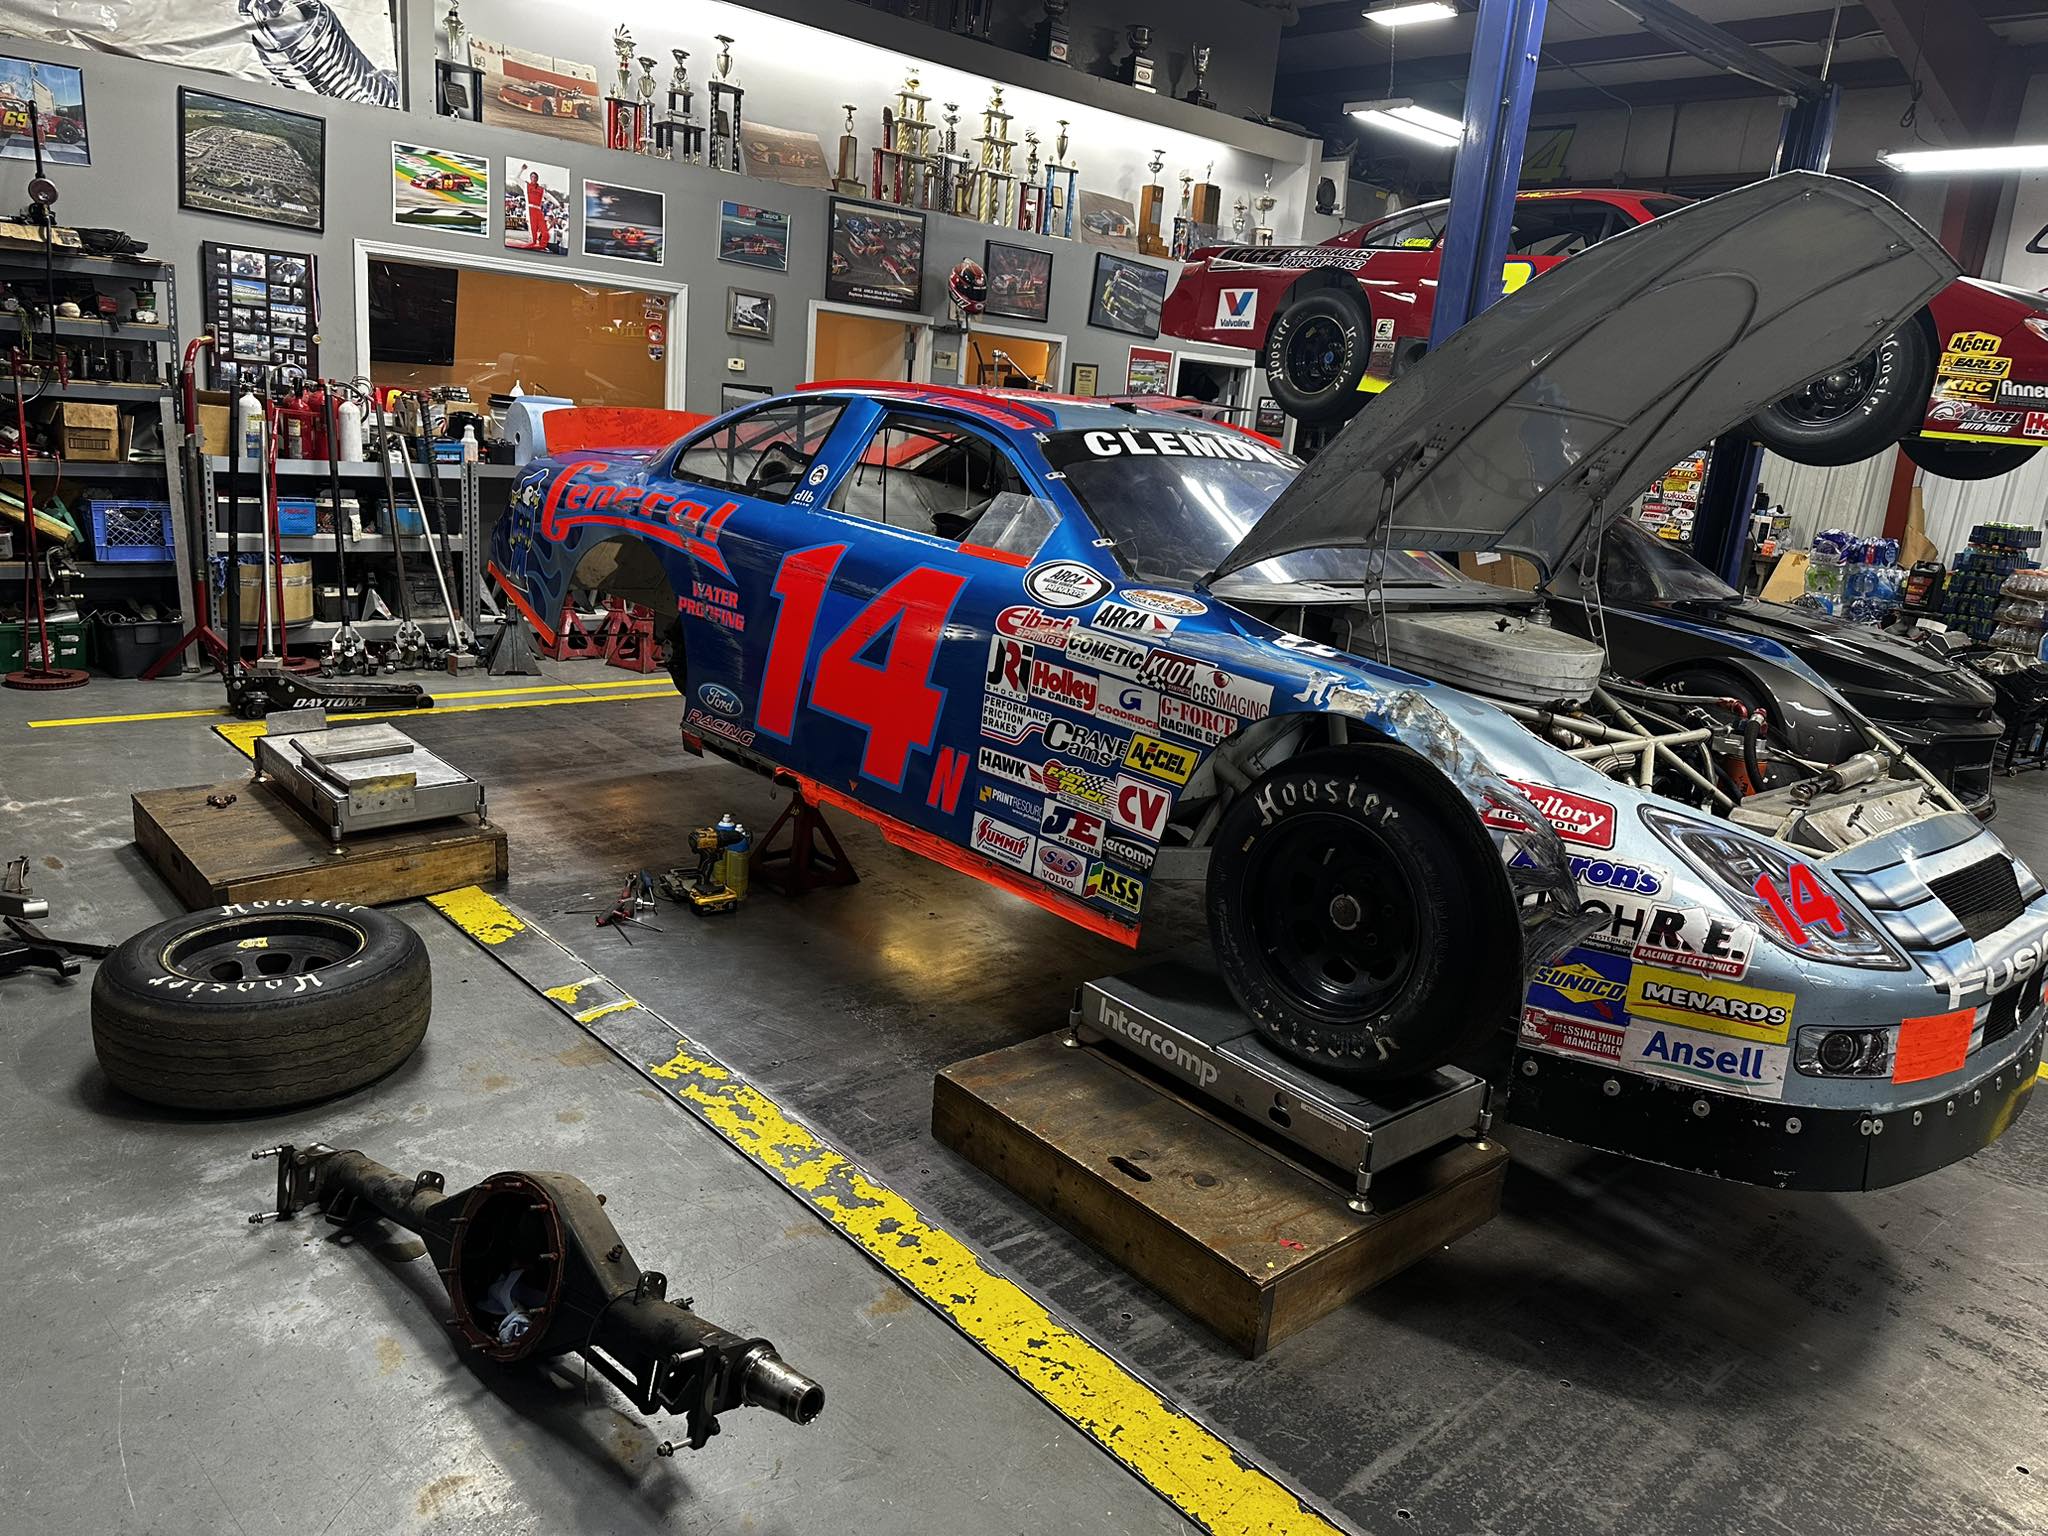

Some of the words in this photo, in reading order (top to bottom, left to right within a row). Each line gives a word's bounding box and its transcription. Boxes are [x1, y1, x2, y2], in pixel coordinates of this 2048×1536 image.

[3, 111, 28, 129] 69
[1220, 318, 1250, 328] Valvoline
[1269, 318, 1290, 382] Hoosier
[1952, 334, 1996, 352] ACCEL
[1863, 333, 1898, 416] Hoosier
[1954, 357, 2007, 370] EARL'S
[1942, 379, 1993, 393] KRC
[1958, 422, 1982, 431] AUTO
[1983, 424, 2011, 433] PARTS
[1959, 409, 2022, 425] ACCEL
[1050, 569, 1084, 584] ARCA
[692, 580, 739, 609] WATER
[1093, 604, 1150, 631] ARCA
[1014, 629, 1063, 646] SPRINGS
[1068, 636, 1144, 670] COMETIC
[754, 542, 975, 791] 14
[926, 746, 969, 815] N
[1033, 661, 1097, 711] Holley
[293, 697, 367, 708] DAYTONA
[706, 687, 734, 714] Ford
[986, 683, 1028, 702] SHOCKS
[1031, 686, 1046, 697] HP
[1048, 691, 1084, 709] CARBS
[983, 706, 1024, 726] FRICTION
[984, 696, 1051, 723] PERFORMANCE
[1098, 704, 1159, 730] GOODRIDGE
[1161, 697, 1236, 736] G-FORCE
[687, 708, 756, 746] RACING
[982, 717, 1018, 734] BRAKES
[1161, 716, 1202, 741] RACING
[981, 749, 1027, 779] HAWK
[1130, 742, 1187, 777] ACCEL
[1047, 766, 1086, 785] FAST
[1059, 780, 1108, 805] TRACK
[1254, 774, 1400, 826] Hoosier
[1118, 785, 1166, 832] CV
[1042, 806, 1101, 847] JE
[1057, 834, 1100, 857] PISTONS
[1043, 869, 1074, 889] VOLVO
[1101, 869, 1140, 905] RSS
[220, 899, 370, 916] Hoosier
[1752, 862, 1848, 947] 14
[1639, 949, 1674, 964] RACING
[1676, 955, 1738, 974] ELECTRONICS
[149, 974, 323, 1000] Hoosier
[1535, 967, 1627, 1001] SUNOCO
[1642, 982, 1787, 1025] MENARDS
[1098, 996, 1221, 1088] Intercomp
[1553, 1023, 1596, 1041] MESSINA
[1642, 1031, 1763, 1080] Ansell
